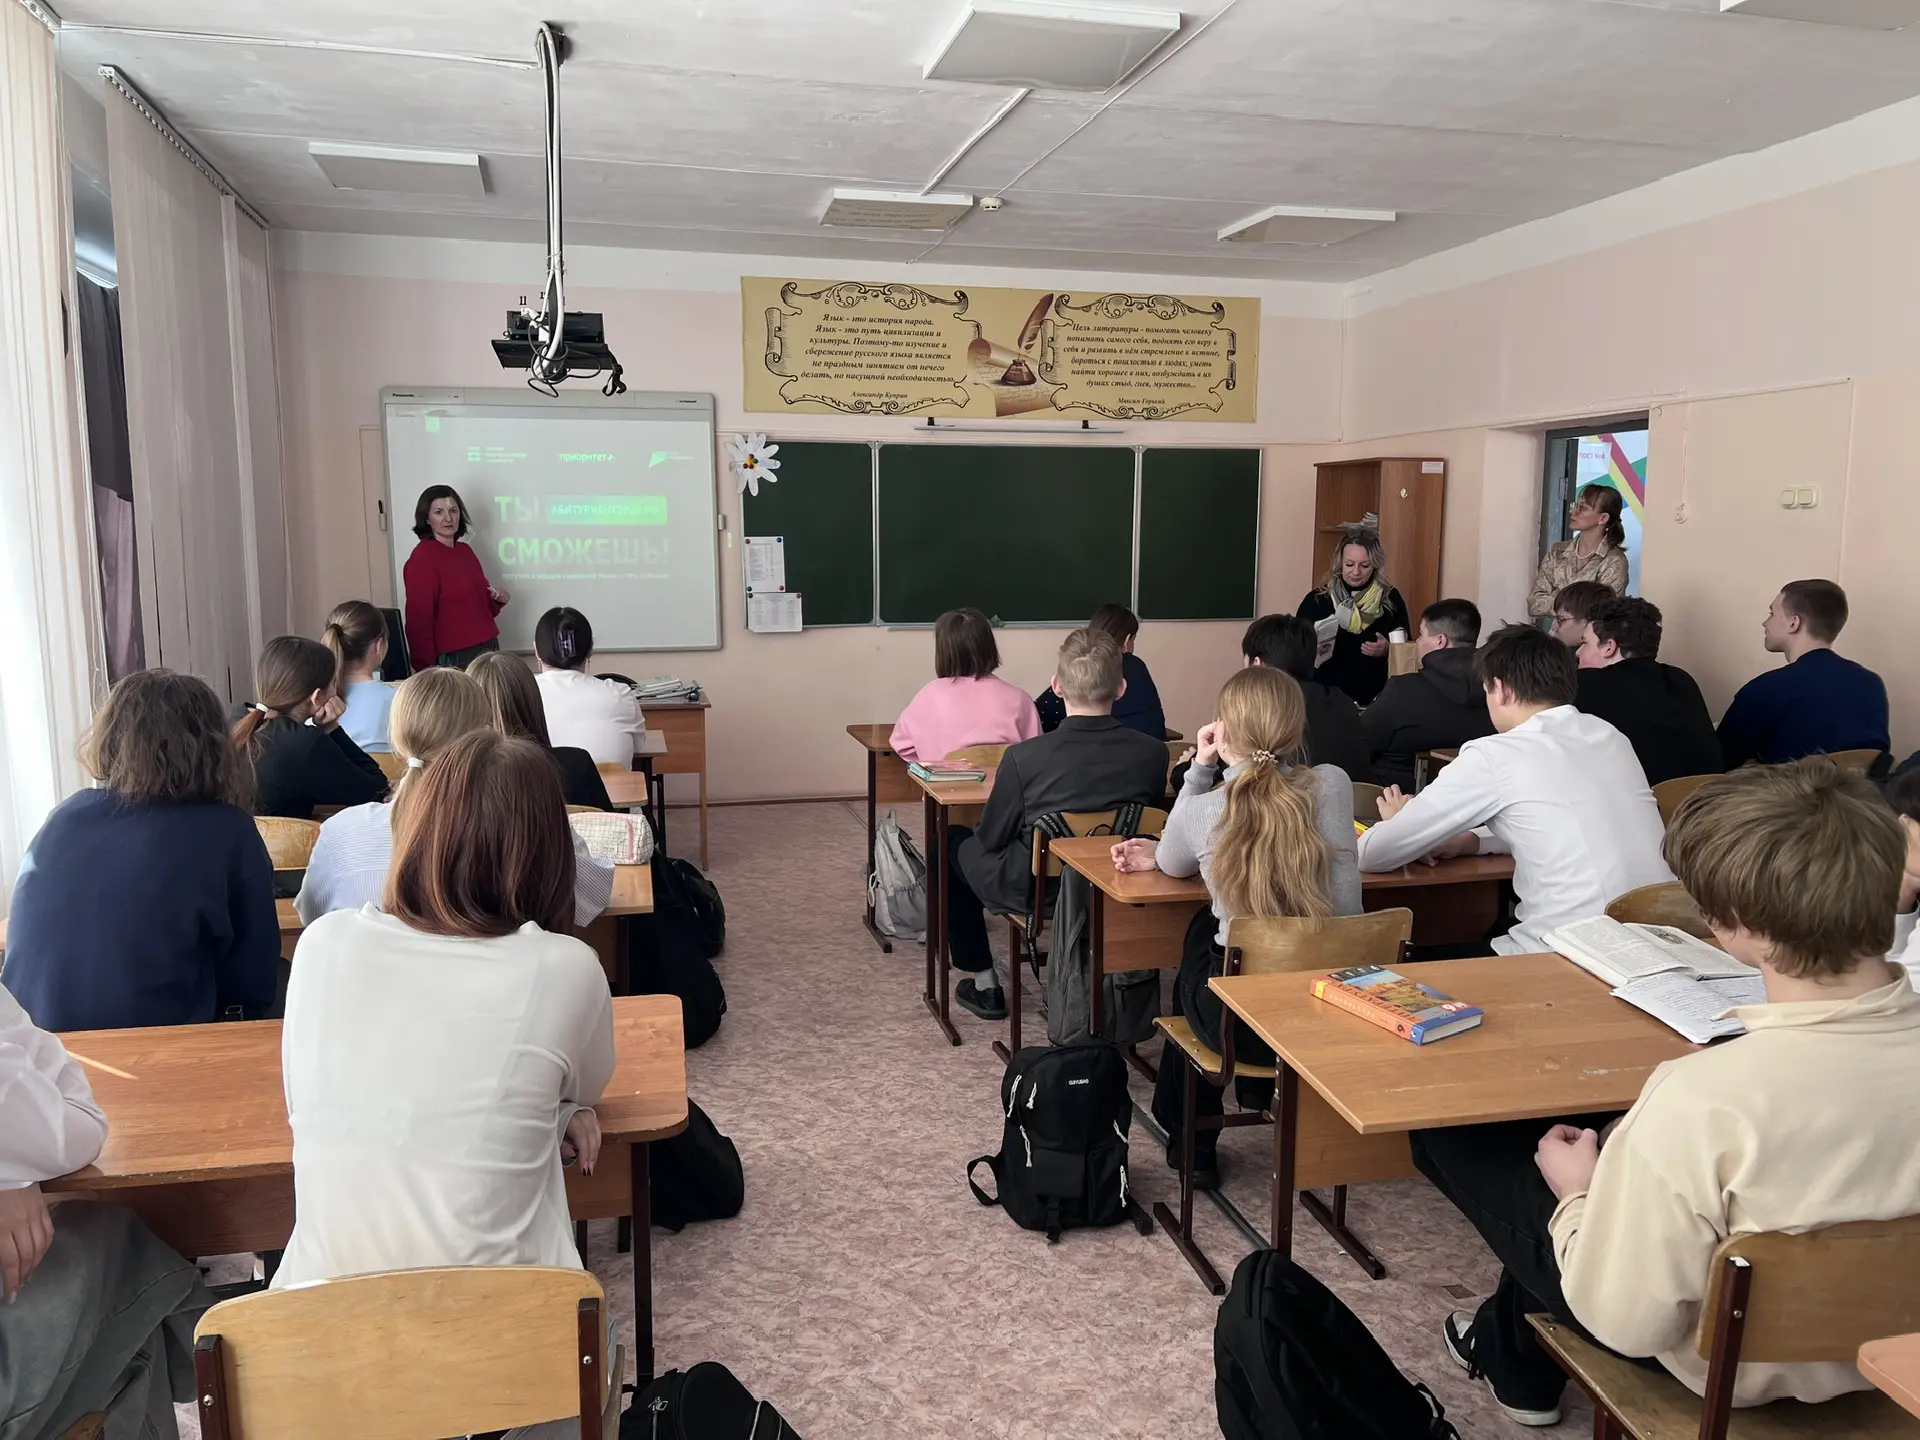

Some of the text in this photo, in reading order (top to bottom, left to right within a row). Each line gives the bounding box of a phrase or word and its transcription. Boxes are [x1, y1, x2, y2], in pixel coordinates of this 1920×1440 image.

[822, 313, 844, 322] Язык
[868, 317, 903, 326] история
[904, 317, 934, 327] народа.
[815, 324, 837, 333] Язык
[861, 328, 882, 336] путь
[883, 329, 935, 337] цивилизации
[1072, 323, 1091, 332] Цель
[1091, 325, 1139, 335] литературы
[1145, 327, 1181, 335] помогать
[1182, 328, 1213, 337] человеку
[809, 337, 851, 347] культуры.
[853, 337, 904, 348] Поэтому-то
[905, 340, 940, 349] изучение
[1066, 335, 1105, 343] понимать
[1132, 336, 1151, 345] себя,
[1151, 337, 1183, 345] поднять
[1197, 340, 1212, 348] веру
[804, 347, 854, 357] сбережение
[853, 350, 888, 359] русского
[914, 352, 952, 360] является
[1063, 345, 1079, 354] себя
[1086, 347, 1118, 355] развить
[1140, 348, 1184, 357] стремление
[812, 360, 822, 368] не
[823, 360, 863, 370] праздным
[865, 362, 905, 370] занятием
[919, 364, 945, 372] нечего
[1070, 356, 1106, 366] бороться
[1189, 361, 1212, 369] уметь
[800, 370, 832, 380] делать,
[845, 372, 886, 382] насущной
[1070, 368, 1096, 376] найти
[1097, 370, 1129, 378] хорошее
[1134, 370, 1151, 378] них,
[1151, 370, 1196, 379] возбуждать
[1086, 380, 1110, 388] душах
[1110, 380, 1133, 388] стыд,
[493, 496, 540, 523] ТЫ
[497, 536, 671, 566] СМОЖЕШЬ!
